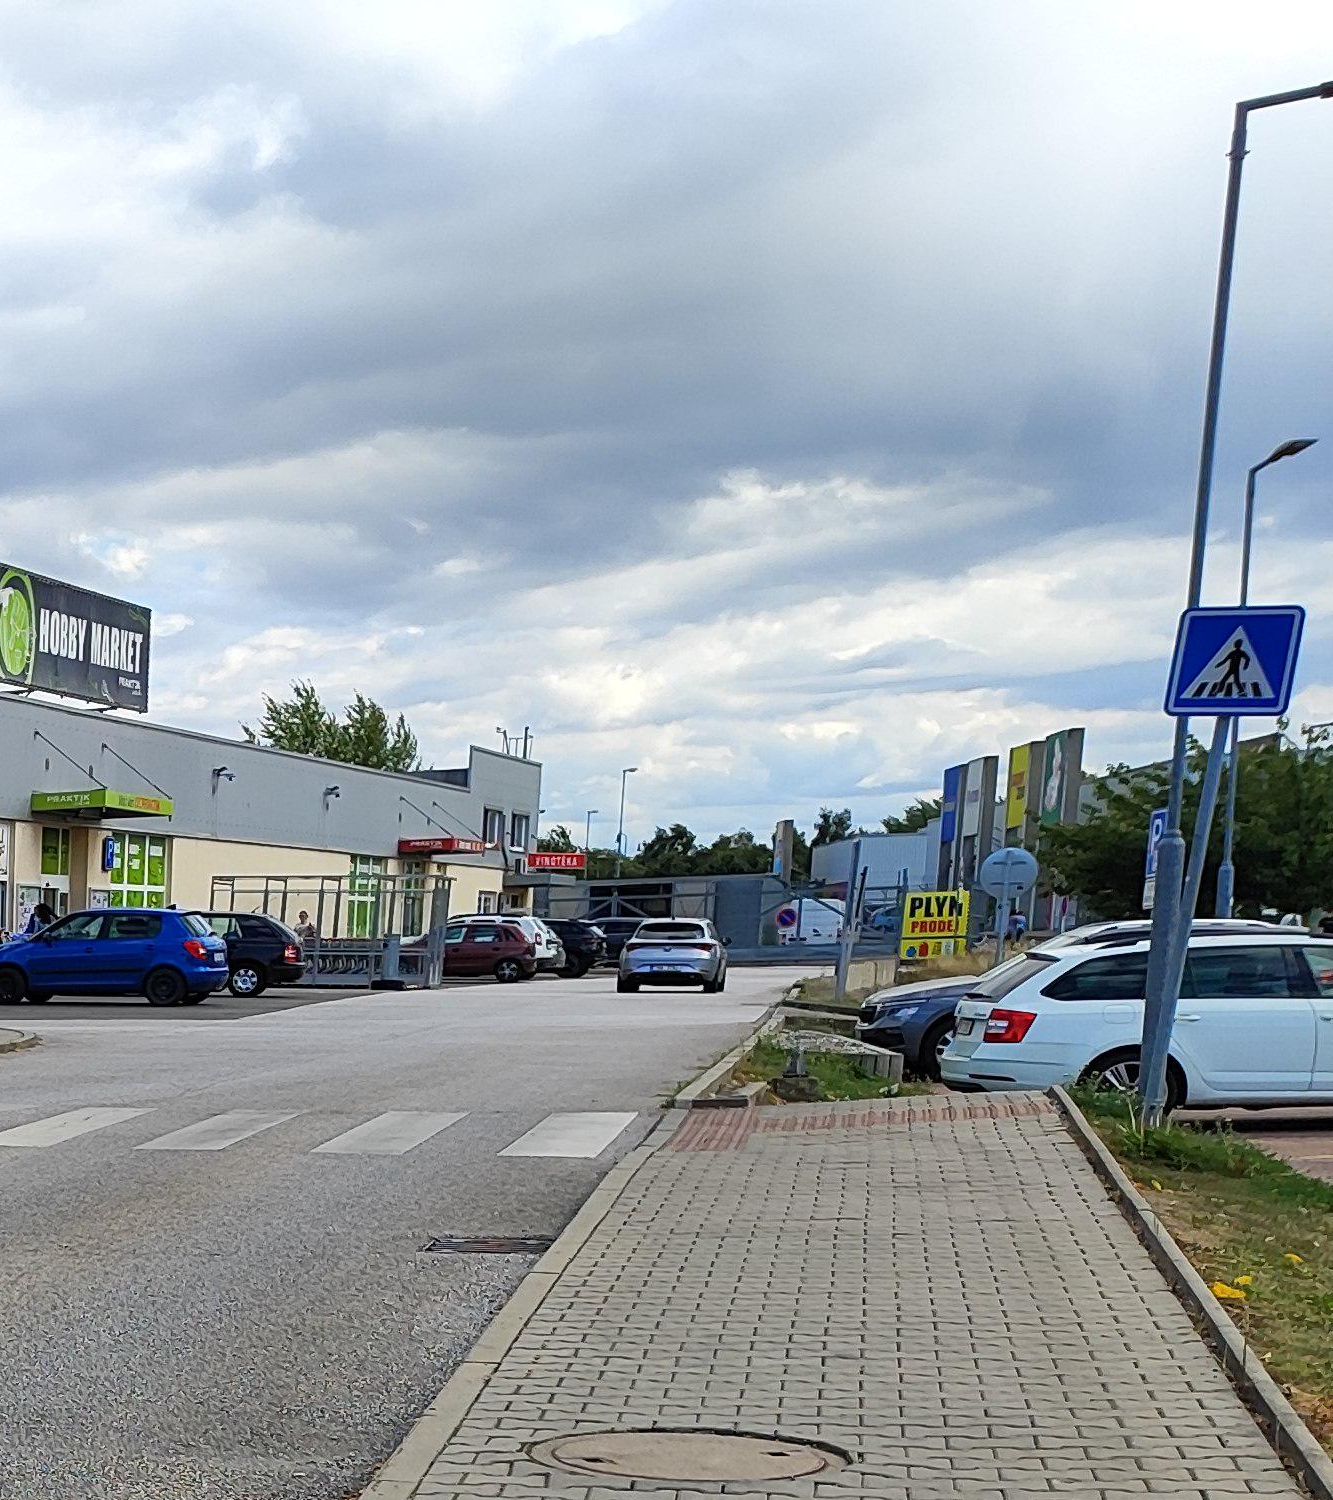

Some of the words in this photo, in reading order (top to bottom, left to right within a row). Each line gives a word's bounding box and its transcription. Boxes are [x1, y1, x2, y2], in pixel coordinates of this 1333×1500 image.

[38, 607, 88, 662] HOBBY
[90, 621, 144, 674] MARKET
[909, 895, 964, 918] PLYN
[910, 919, 959, 934] PRODE
